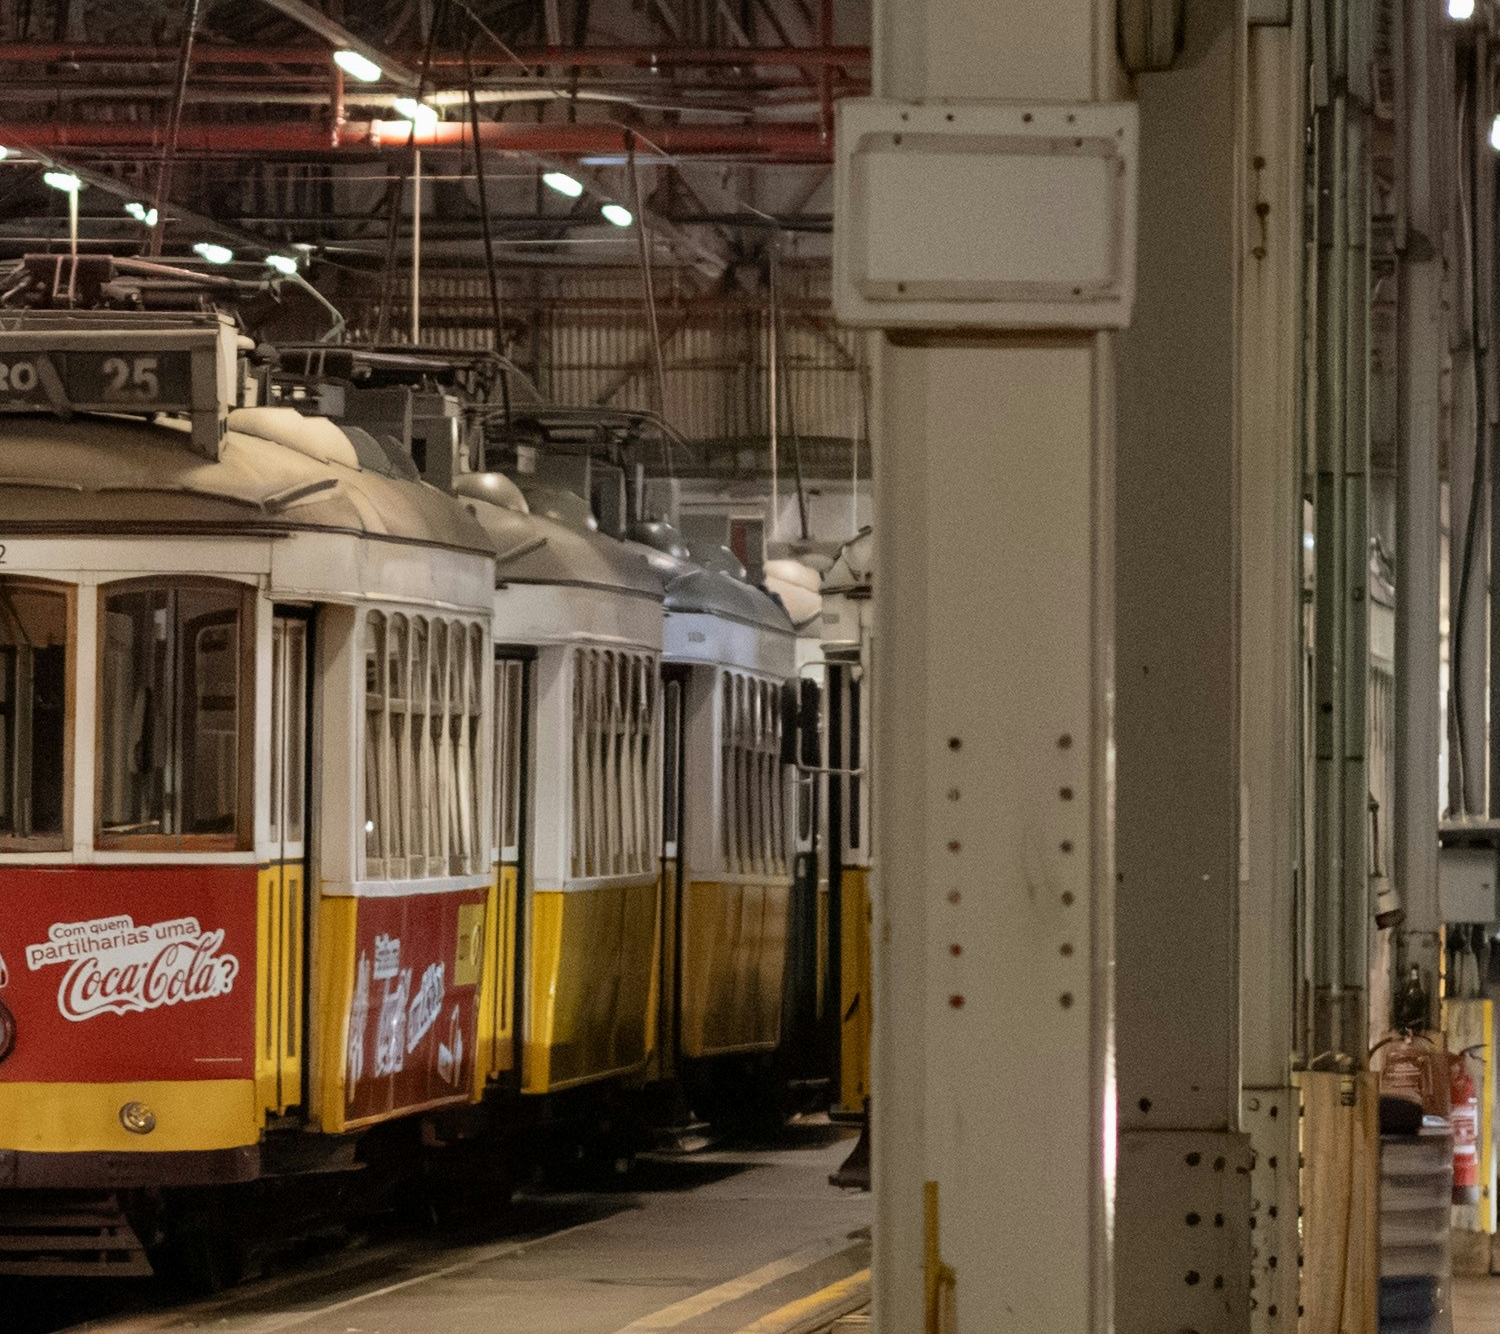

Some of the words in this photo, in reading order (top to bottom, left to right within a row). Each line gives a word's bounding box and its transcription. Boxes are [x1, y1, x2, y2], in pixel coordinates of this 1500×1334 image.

[102, 357, 160, 401] 25
[30, 930, 150, 965] partilharias
[154, 920, 198, 941] uma
[52, 924, 86, 940] Com
[90, 917, 130, 936] quem
